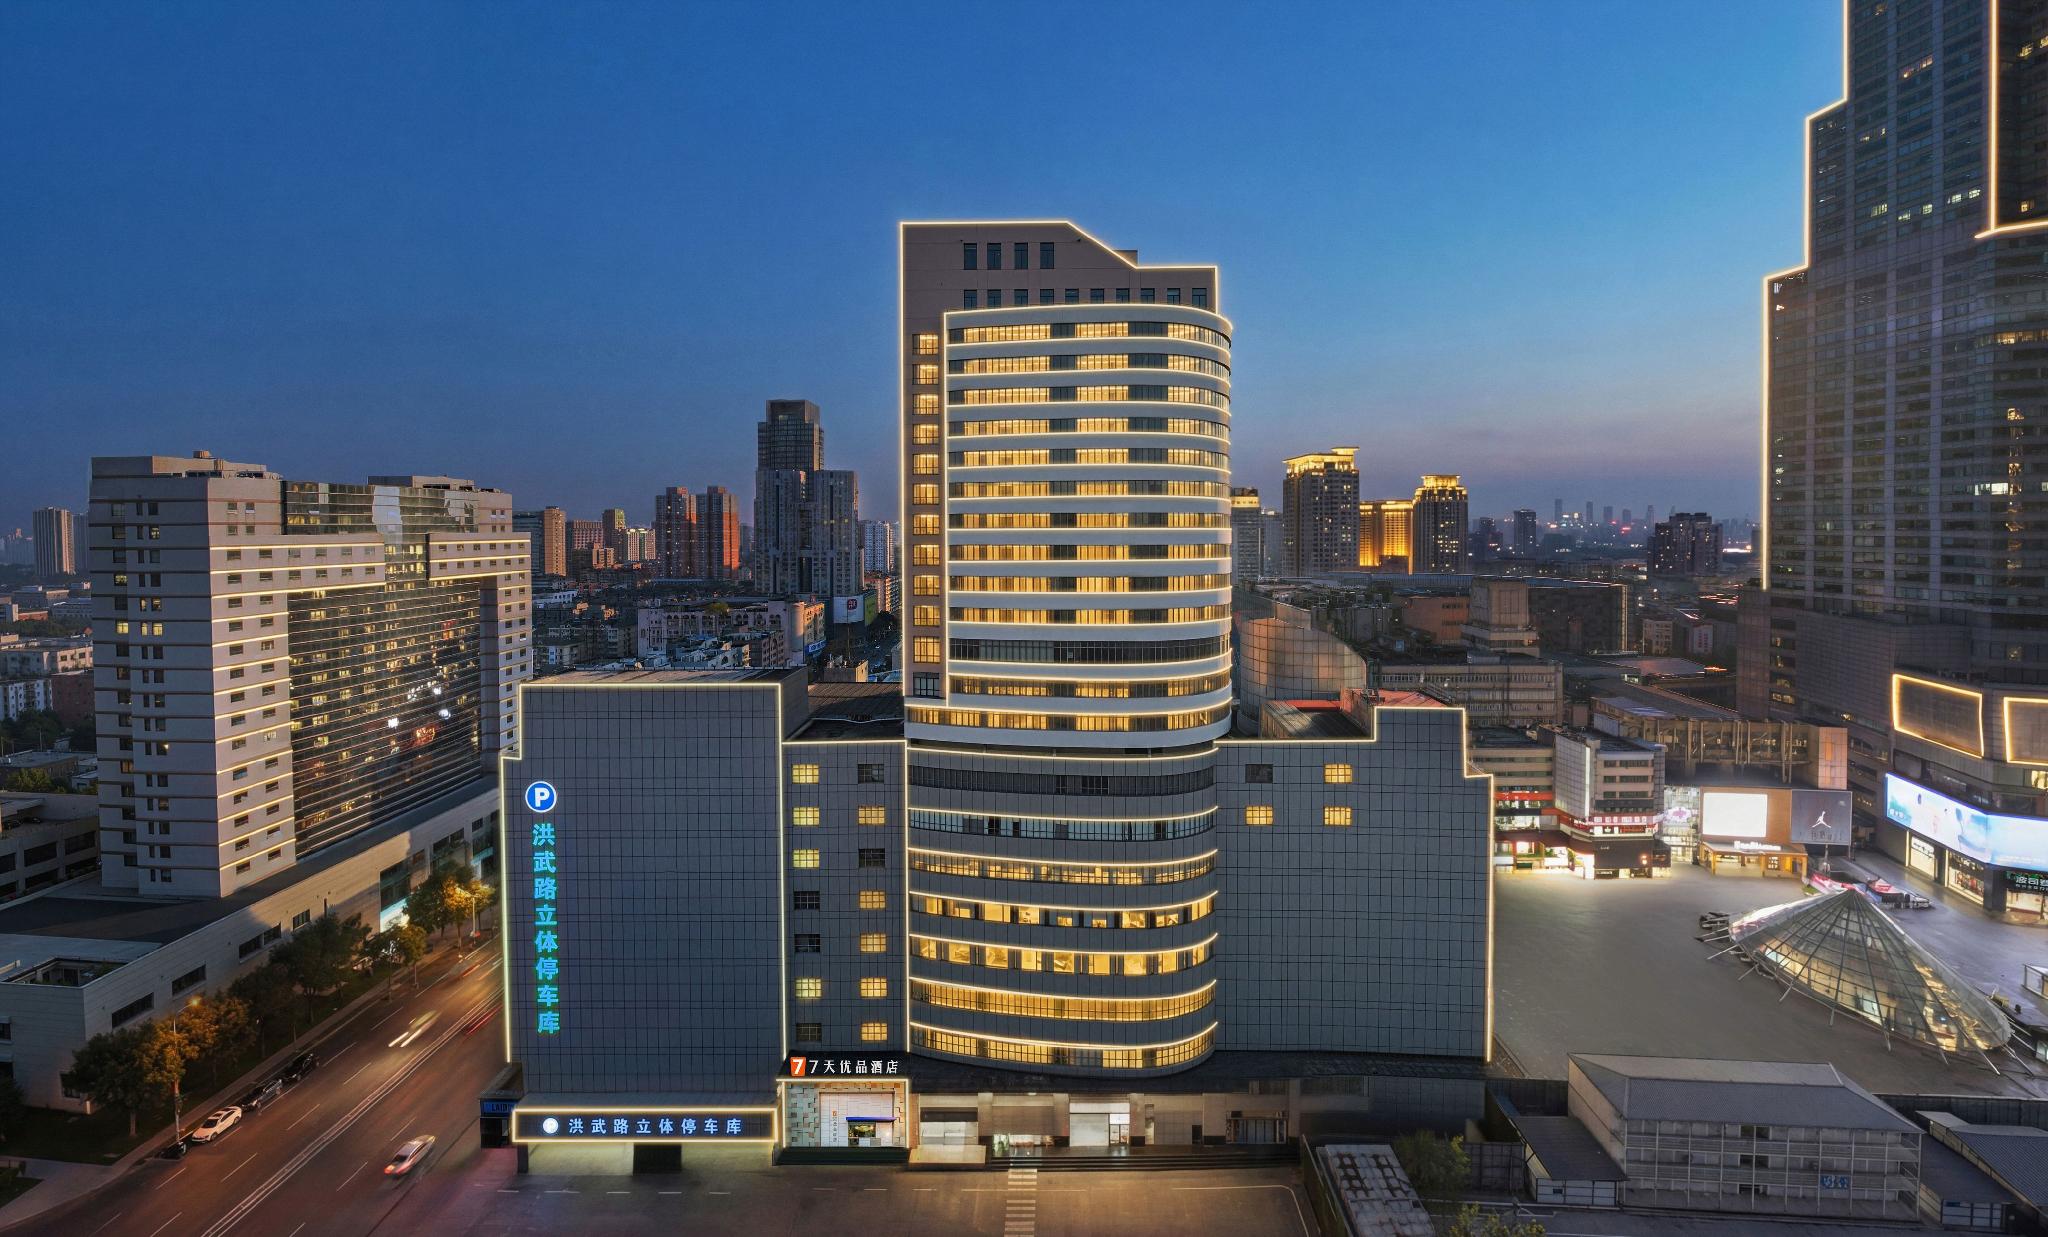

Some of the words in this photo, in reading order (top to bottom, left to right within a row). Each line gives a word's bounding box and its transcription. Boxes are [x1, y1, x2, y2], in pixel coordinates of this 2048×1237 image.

[534, 787, 550, 808] P
[532, 823, 560, 1034] 洪武路立体停车库
[808, 1059, 899, 1075] 7天优品酒店
[568, 1117, 742, 1135] 洪武路立体停车库
